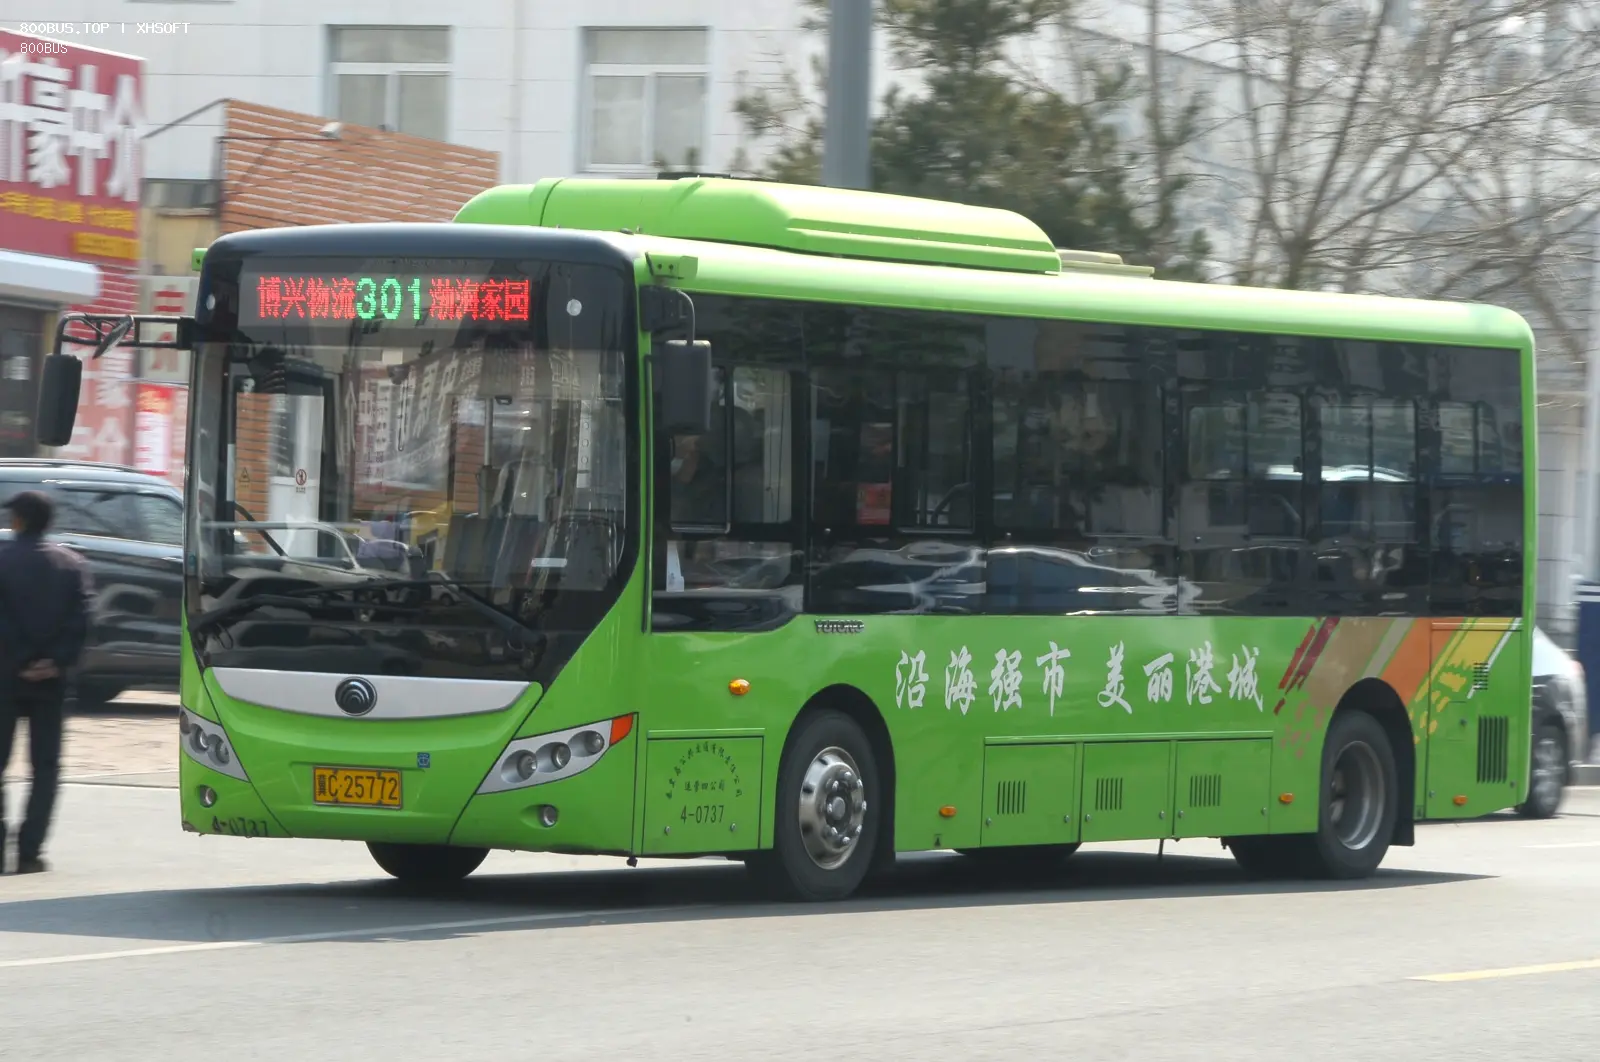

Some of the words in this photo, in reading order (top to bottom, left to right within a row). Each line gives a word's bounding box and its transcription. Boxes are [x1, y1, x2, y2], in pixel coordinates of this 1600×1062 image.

[356, 277, 421, 320] 301
[896, 641, 1071, 717] 沿海强市
[1098, 640, 1264, 715] 美丽港城
[680, 805, 725, 824] 4-0737
